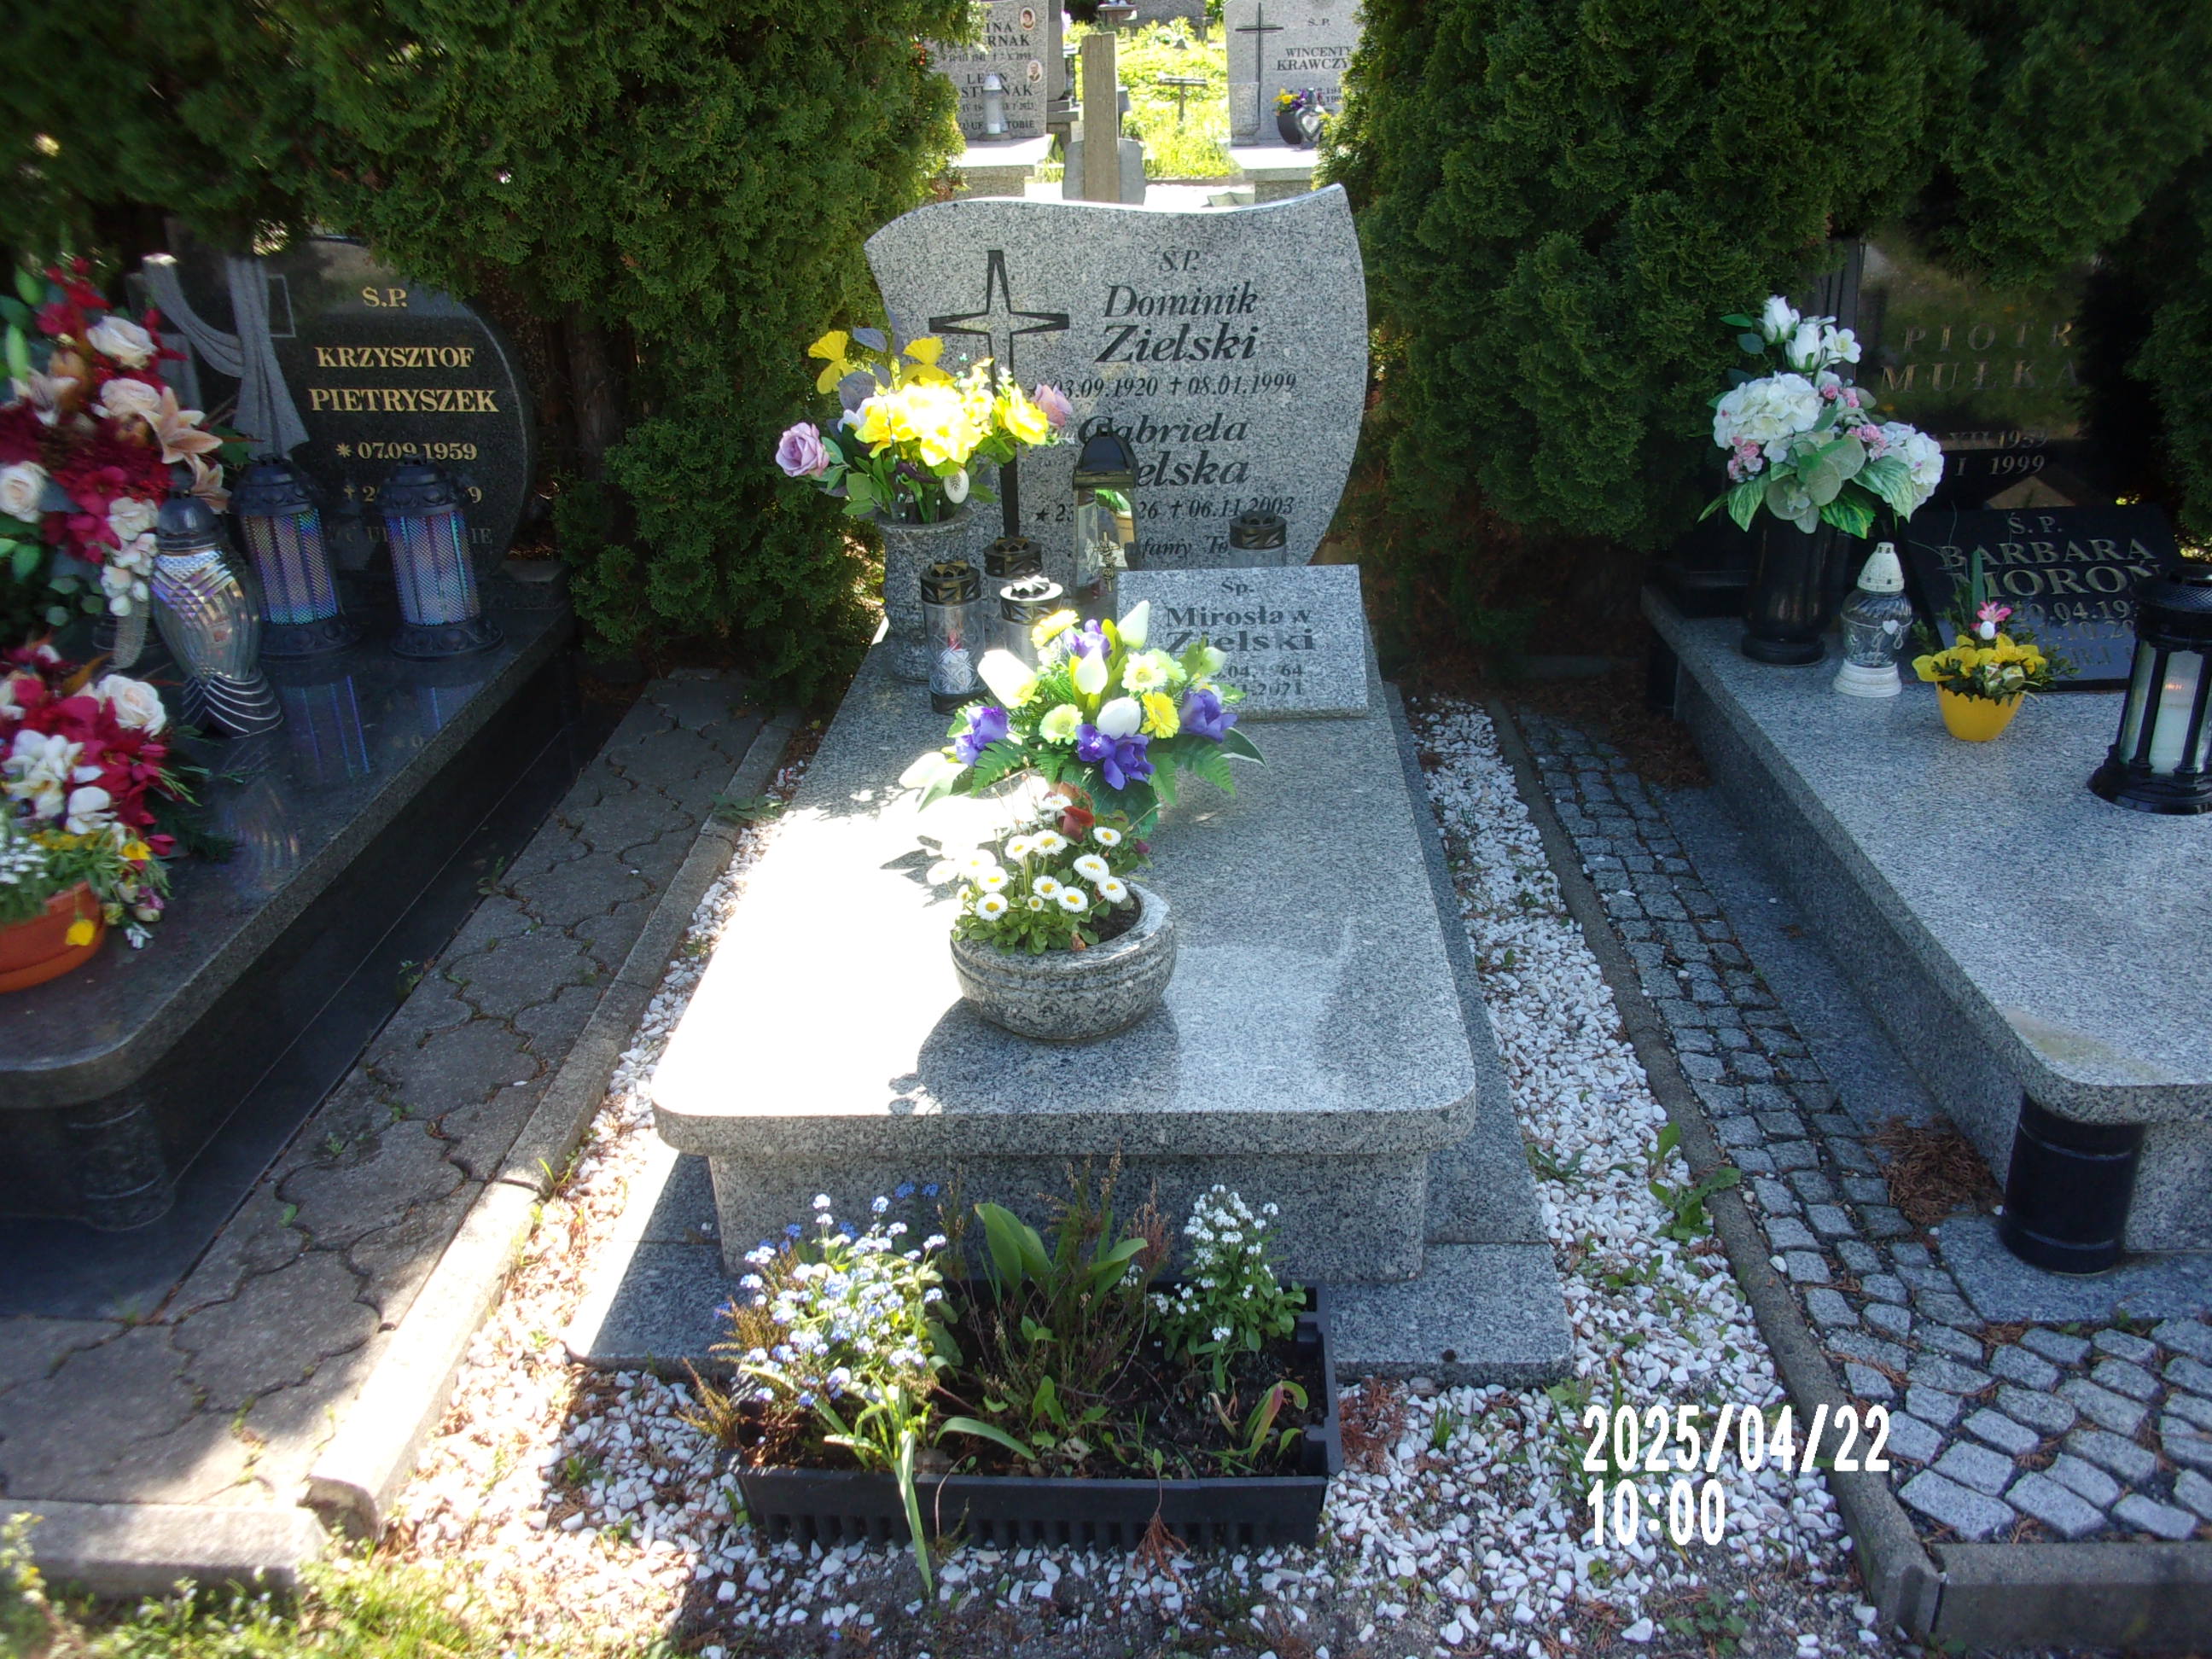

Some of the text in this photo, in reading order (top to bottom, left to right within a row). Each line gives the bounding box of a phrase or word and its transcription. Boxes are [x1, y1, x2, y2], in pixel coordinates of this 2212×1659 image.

[1285, 45, 1353, 58] WINCENTY
[1277, 57, 1348, 71] KRAWCZY
[967, 73, 1008, 84] LEN
[1104, 282, 1260, 317] Dominik
[1094, 321, 1259, 364] Zielski
[314, 346, 475, 369] KRZYSZTOF
[1187, 372, 1296, 396] 08.01.1999
[308, 387, 500, 414] PIETRYSZEK
[1137, 450, 1251, 487] elska
[1988, 453, 2046, 476] 1999
[1936, 537, 2158, 571] BARBARA
[1167, 606, 1313, 627] Mirosław
[1166, 628, 1315, 654] Zielski
